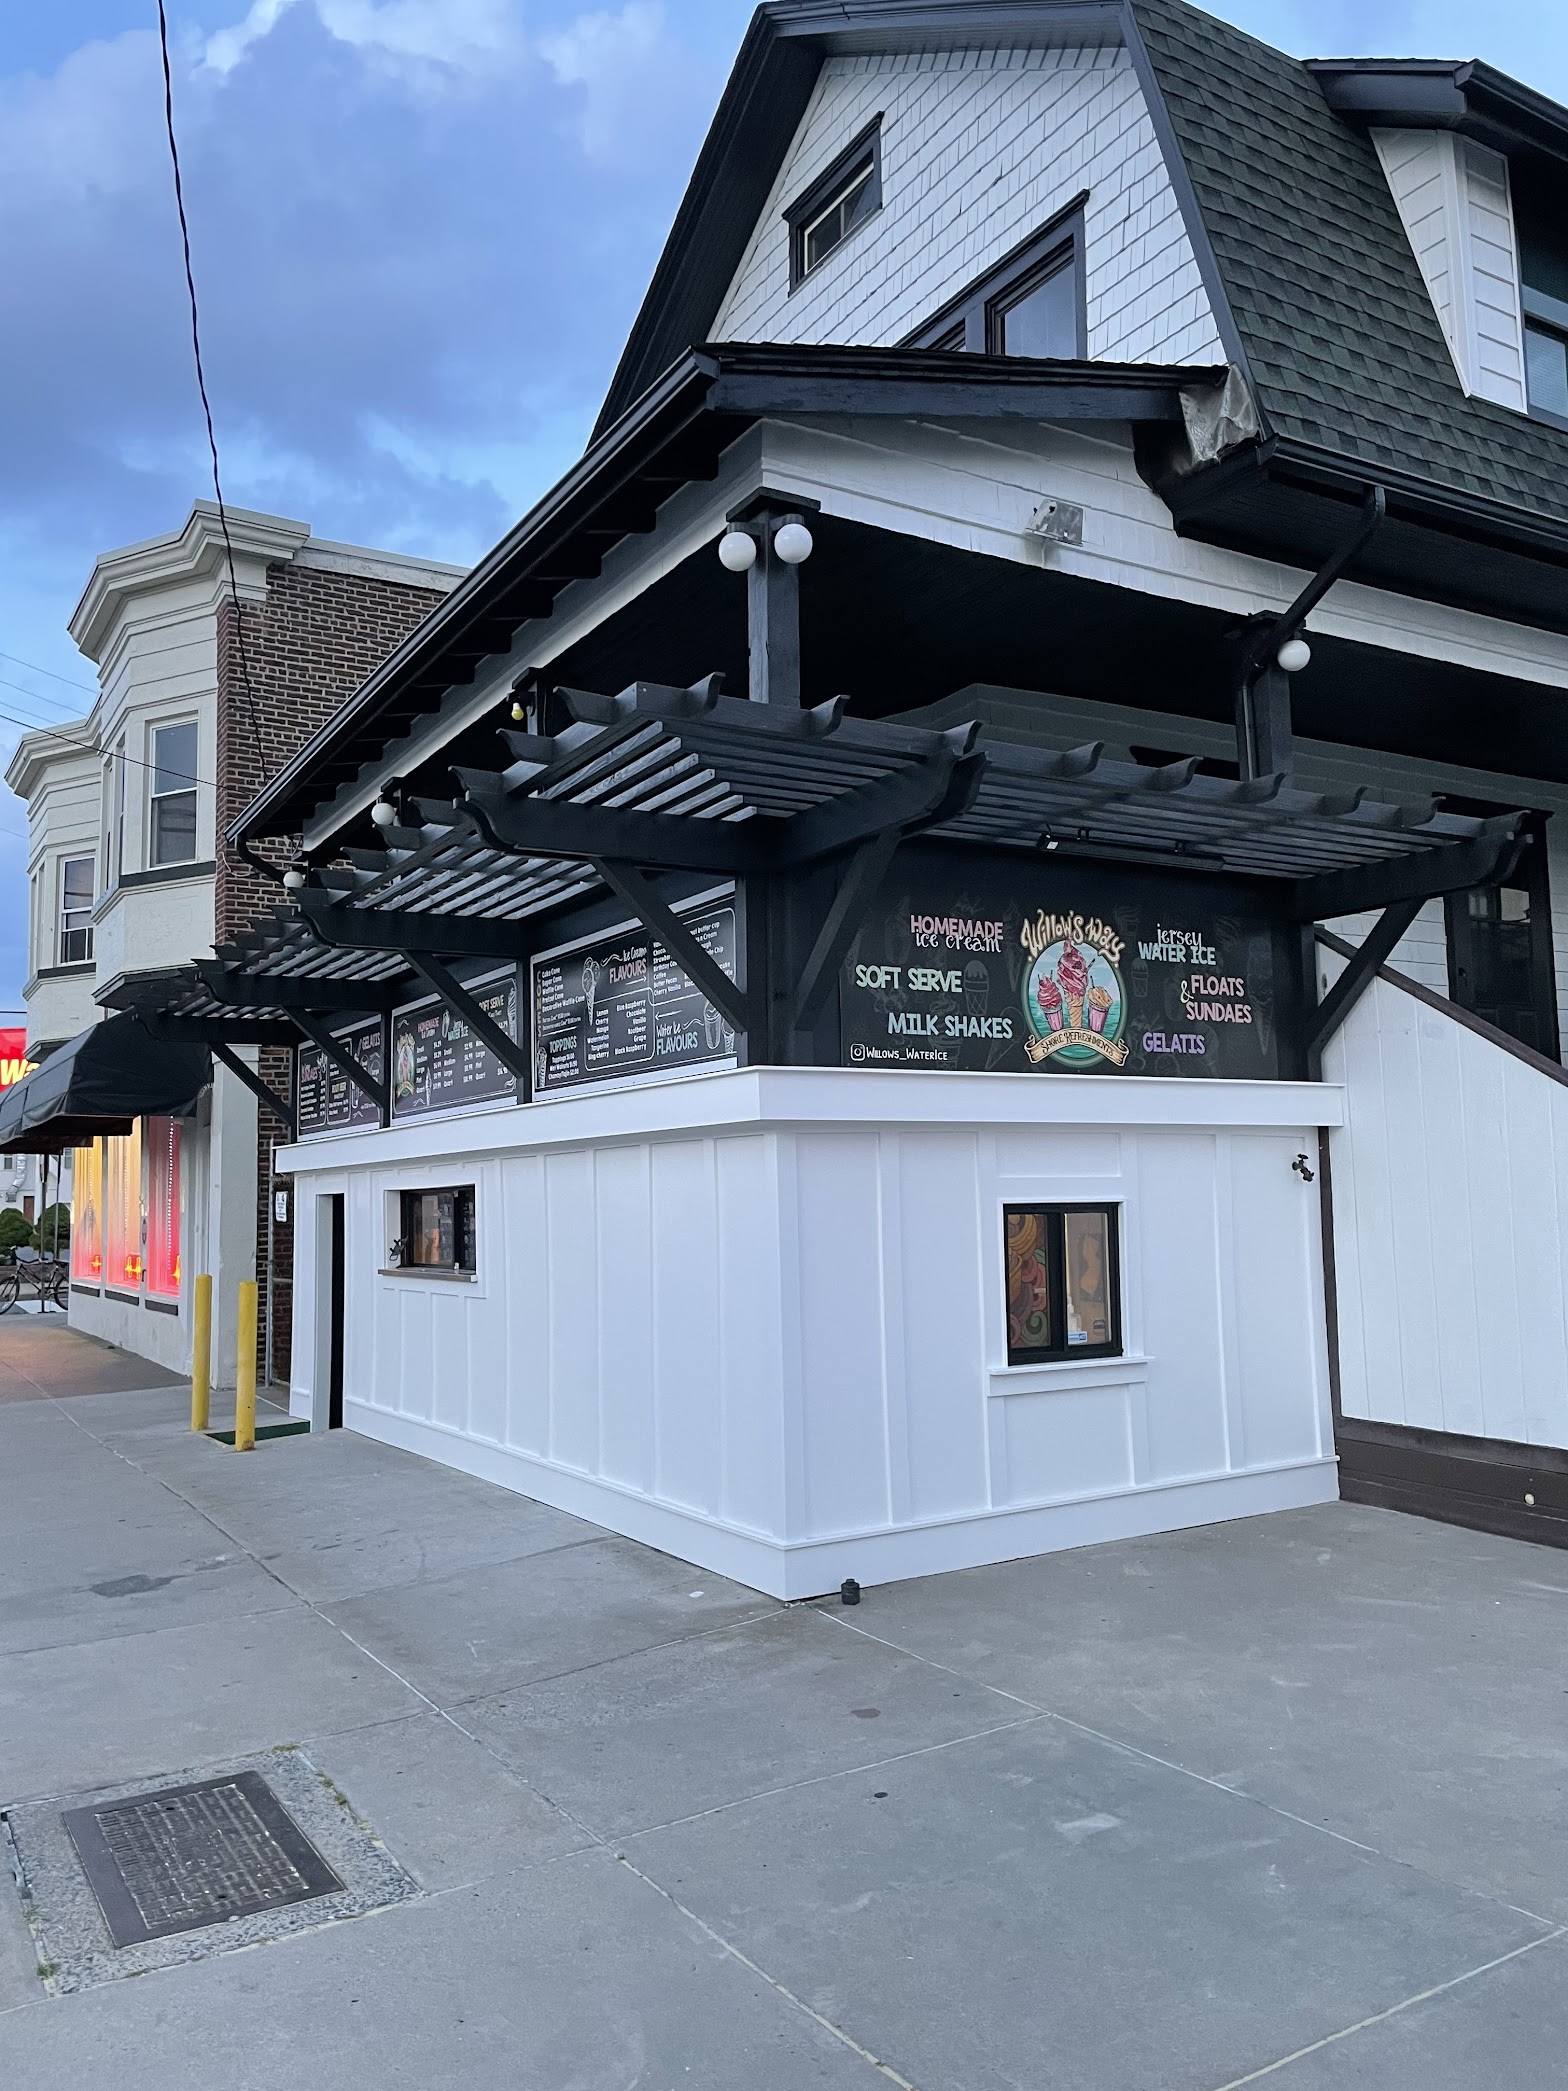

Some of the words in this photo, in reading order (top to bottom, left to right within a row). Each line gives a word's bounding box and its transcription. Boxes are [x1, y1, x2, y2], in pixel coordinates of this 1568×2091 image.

[910, 914, 1004, 941] HOMEMADE
[1156, 923, 1202, 953] jersey
[915, 929, 939, 948] ice
[945, 934, 1002, 953] cream
[1138, 941, 1187, 963] WATER
[1190, 945, 1217, 966] ICE
[609, 957, 647, 984] FLAVOURS
[855, 964, 902, 989] SOFT
[907, 967, 963, 993] SERVE
[1180, 980, 1194, 1003] &
[1191, 974, 1245, 997] FLOATS
[1185, 1001, 1252, 1024] SUNDAES
[888, 1012, 940, 1037] MILK
[944, 1015, 1013, 1039] SHAKES
[549, 1035, 577, 1054] TOPPINGS
[656, 1031, 698, 1056] FLAVOURS
[1142, 1031, 1206, 1054] GELATIS
